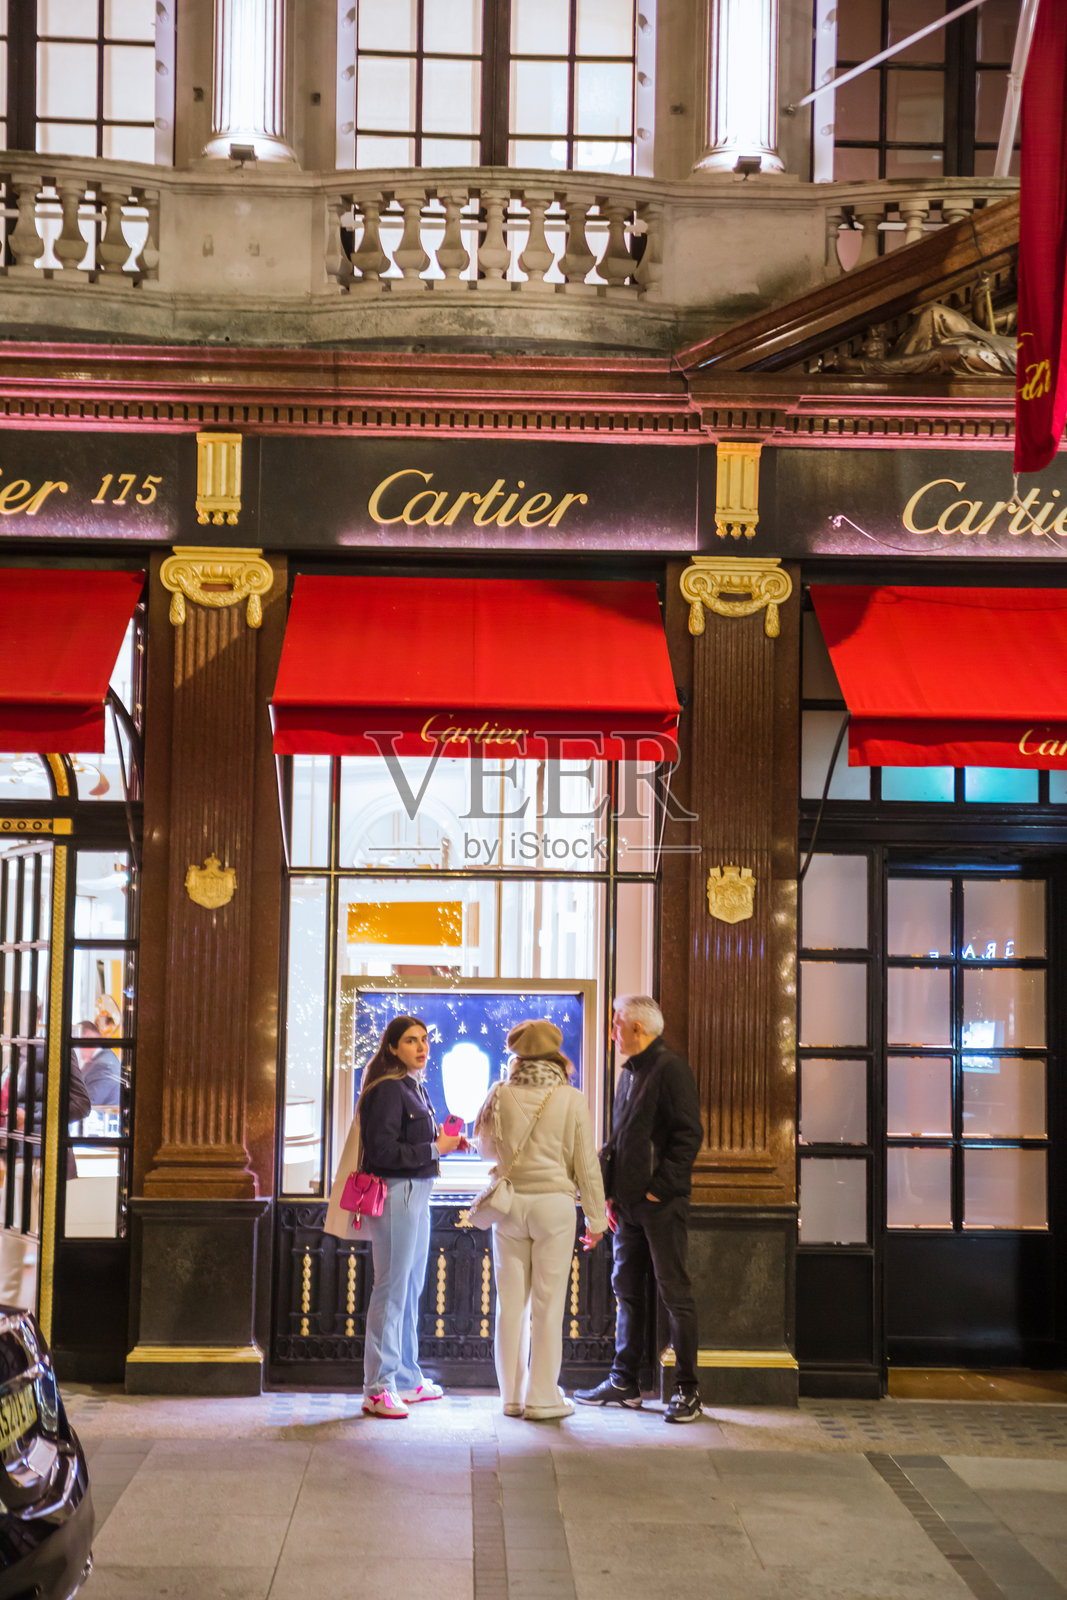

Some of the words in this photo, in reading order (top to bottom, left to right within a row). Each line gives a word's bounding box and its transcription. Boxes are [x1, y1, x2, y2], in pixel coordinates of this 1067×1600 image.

[90, 473, 163, 505] 175
[367, 468, 589, 528] Cartier
[420, 713, 530, 745] Cartier
